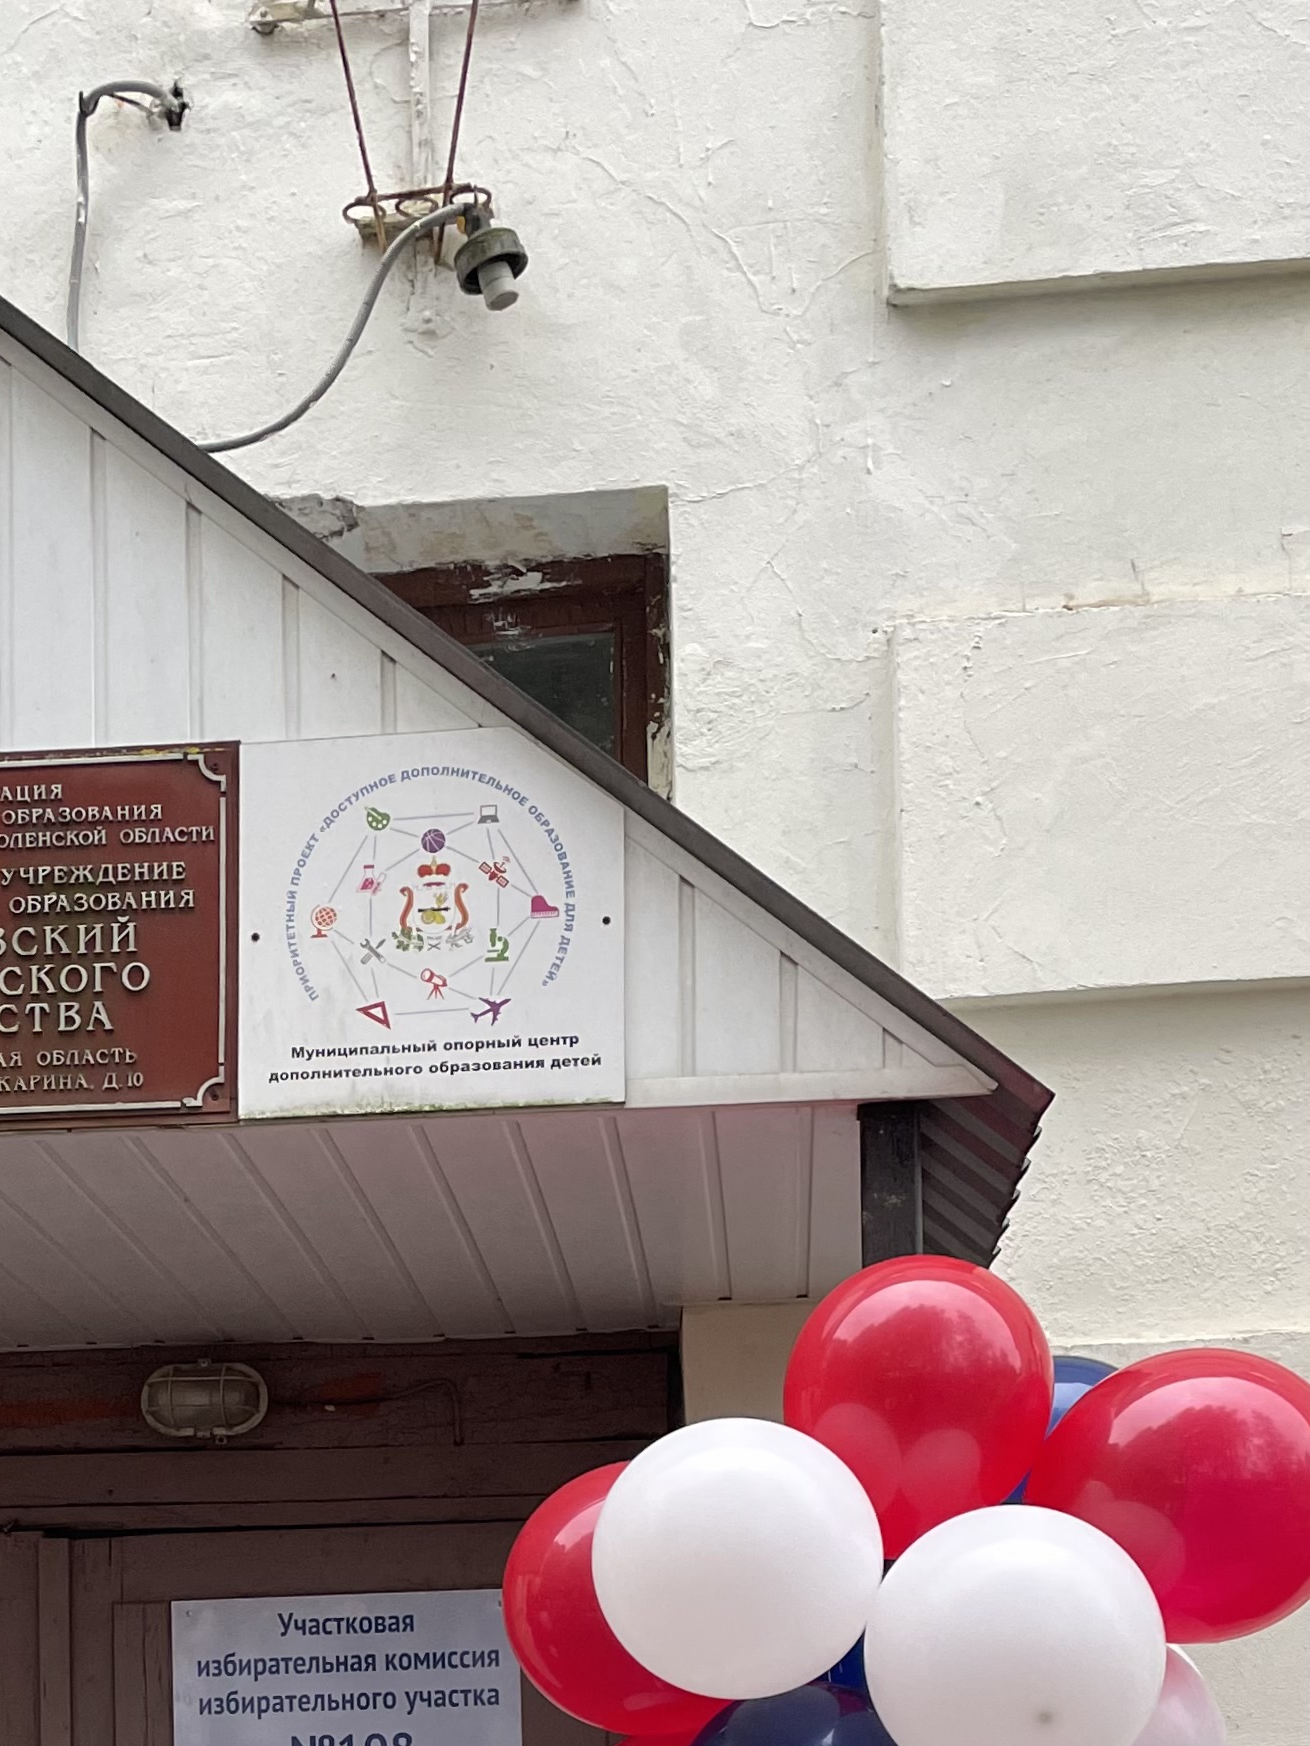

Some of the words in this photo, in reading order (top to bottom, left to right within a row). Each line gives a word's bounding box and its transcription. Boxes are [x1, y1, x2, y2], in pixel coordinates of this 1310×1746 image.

[401, 766, 529, 807] ДОПОЛНИТЕЛЬНОЕ
[2, 804, 163, 826] ОБРАЗОВАНИЯ
[319, 773, 397, 834] «ДОСТУПНОЕ
[120, 826, 214, 844] ОБЛАСТИ
[291, 837, 319, 887] ПРОЕКТ
[528, 805, 575, 899] ОБРАЗОВАНИЕ
[1, 861, 186, 885] УЧРЕЖДЕНИЕ
[10, 890, 195, 914] ОБРАЗОВАНИЯ
[564, 903, 575, 932] ДЛЯ
[285, 889, 319, 1002] ПРИОРИТЕТНЫЙ
[541, 936, 574, 987] ДЕТЕЙ»
[37, 1048, 137, 1066] ОБЛАСТЬ
[291, 1040, 437, 1061] Муниципальный
[444, 1036, 521, 1053] опорный
[528, 1033, 579, 1049] центр
[269, 1061, 423, 1083] дополнительного
[429, 1057, 544, 1076] образования
[551, 1053, 601, 1069] детей
[278, 1612, 415, 1637] Участковая
[197, 1651, 376, 1680] избирательная
[385, 1648, 499, 1671] комиссия
[199, 1690, 396, 1719] избирательного
[405, 1686, 499, 1715] участка
